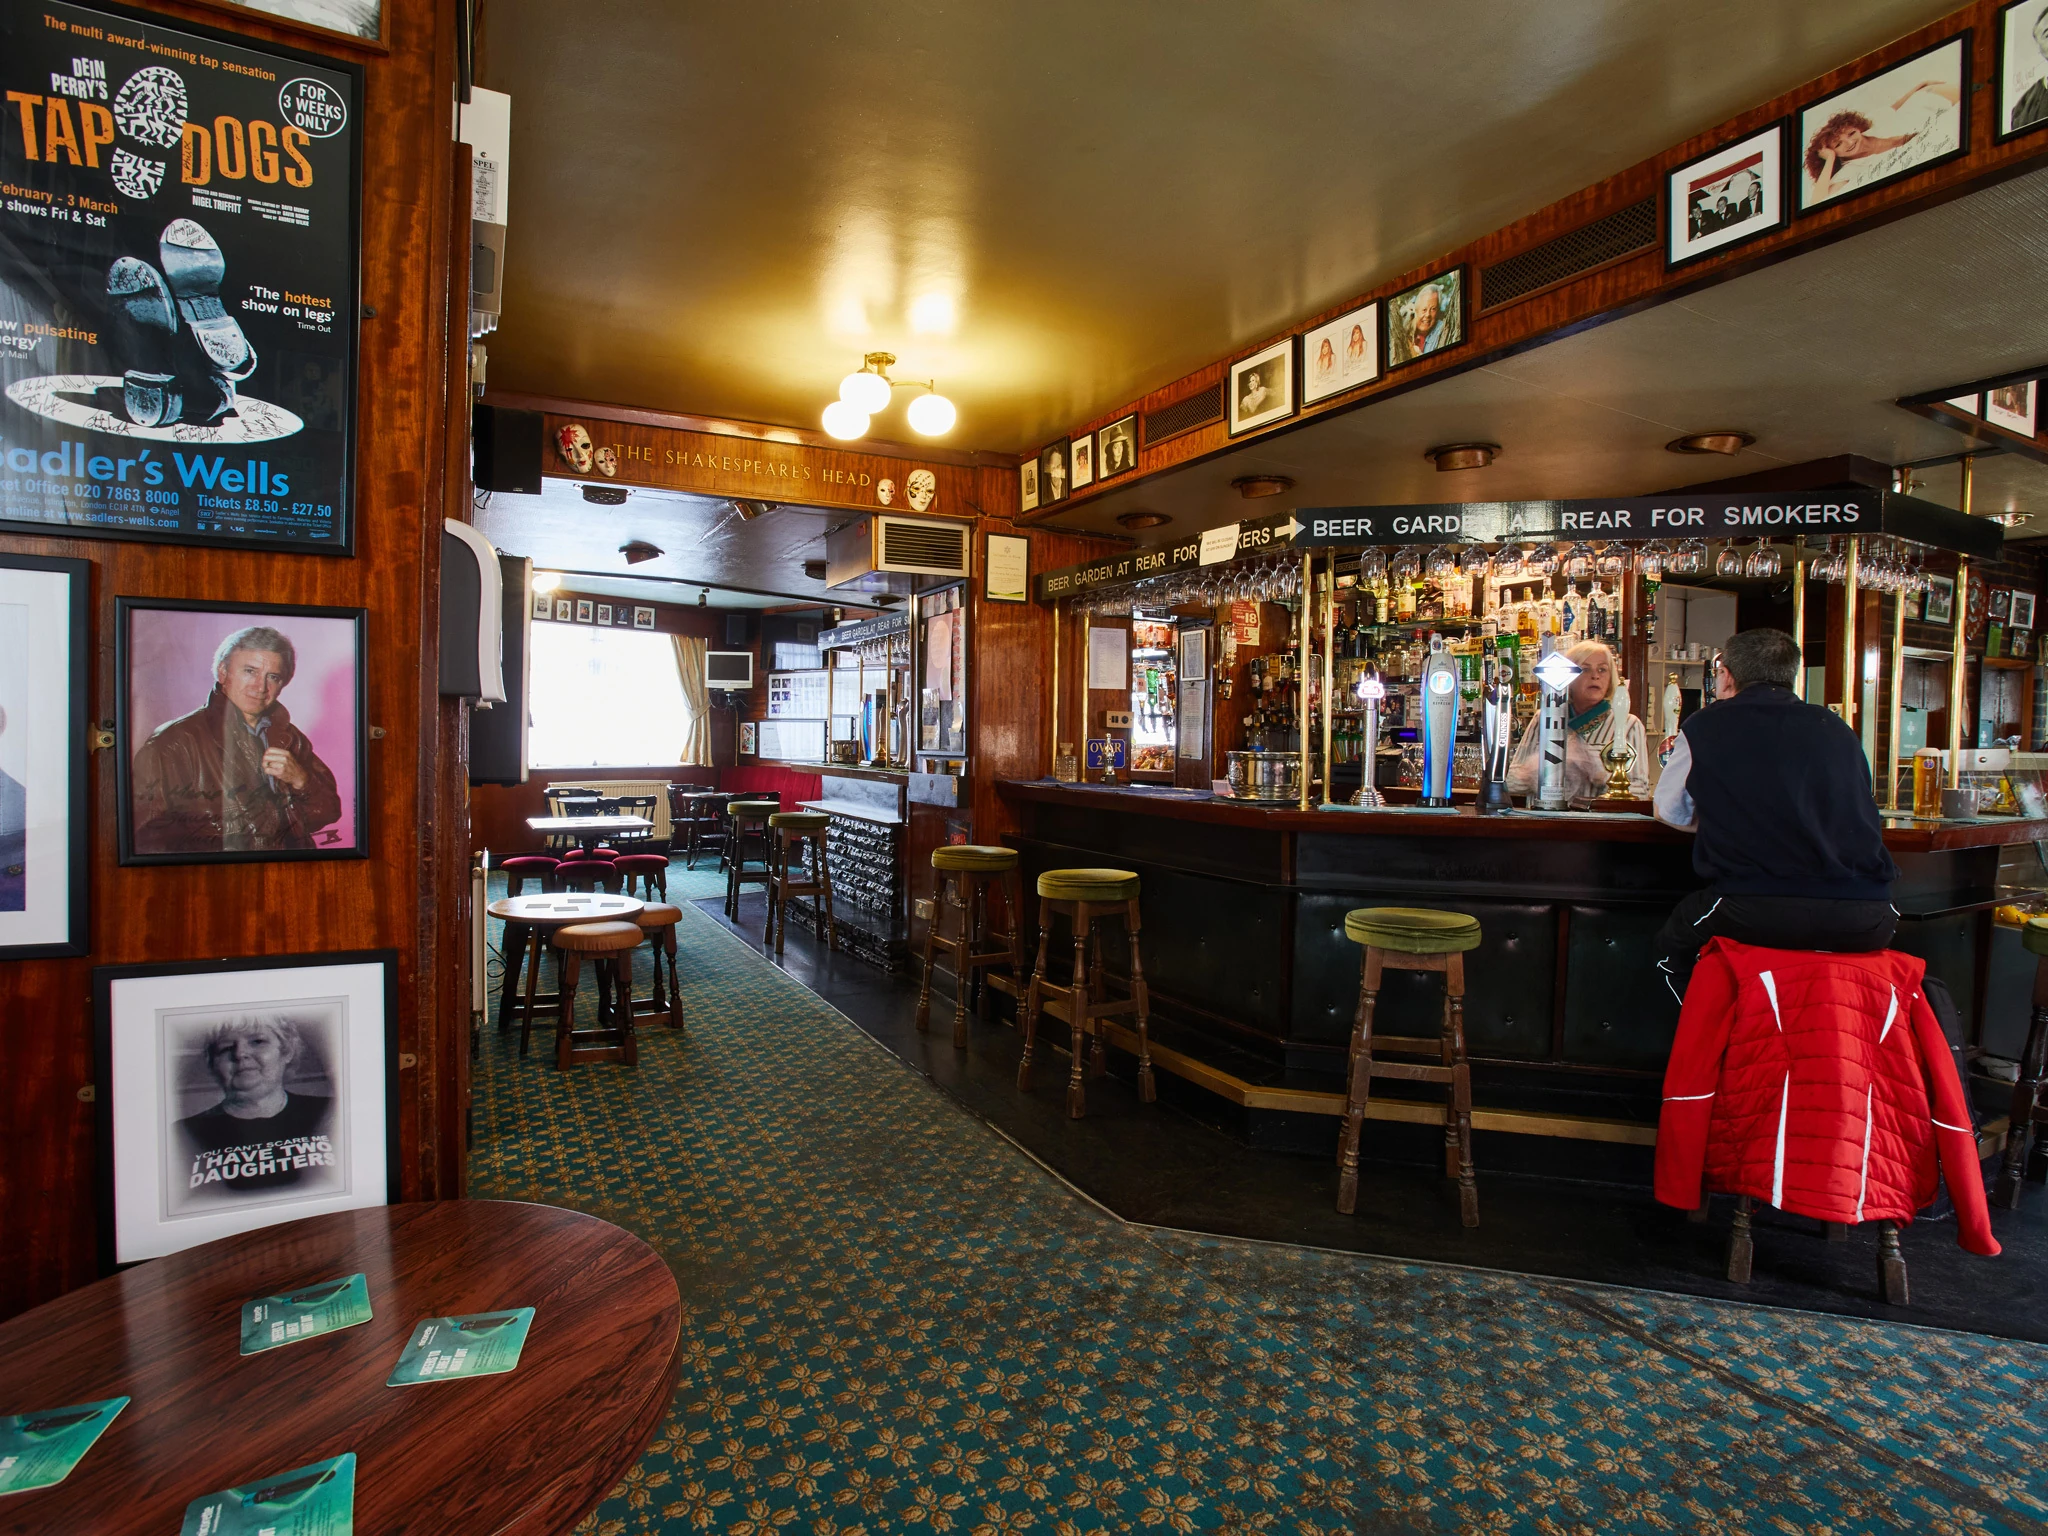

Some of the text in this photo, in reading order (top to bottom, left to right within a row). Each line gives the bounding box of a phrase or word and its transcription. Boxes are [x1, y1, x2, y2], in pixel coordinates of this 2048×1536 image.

[44, 14, 276, 82] The multi award-winning tap sensation
[72, 57, 106, 79] DEIN
[51, 72, 108, 100] PERRY'S
[300, 83, 326, 102] FOR
[283, 94, 342, 120] 3 WEEKS
[295, 112, 330, 132] ONLY
[6, 90, 313, 188] TAP DOGS
[474, 159, 494, 169] SPEL
[7, 200, 48, 217] shows
[52, 206, 68, 220] Fri
[72, 210, 82, 223] &
[86, 213, 106, 228] Sat
[68, 194, 75, 206] 3
[80, 196, 118, 214] March
[192, 195, 242, 214] NIGEL TRIFFITT
[242, 299, 278, 314] show
[282, 306, 300, 317] on
[284, 291, 332, 309] hottest
[24, 323, 98, 344] pulsating
[297, 321, 332, 333] Time Out
[0, 334, 42, 350] ergy’
[8, 350, 28, 360] Mail
[172, 452, 290, 498] Wells
[612, 444, 871, 486] THE SHAKESPEARE'S HEAD
[0, 479, 179, 506] ket Office 020 7863 8000
[6, 505, 40, 517] online
[44, 509, 54, 518] at
[58, 510, 179, 528] www.sadlers-wells.com
[80, 501, 106, 510] London
[109, 502, 128, 512] EC1R
[130, 504, 146, 512] 4TN
[160, 507, 180, 516] Angel
[196, 494, 240, 510] Tickets
[244, 498, 278, 513] £8.50
[292, 502, 332, 518] £27.50
[1312, 518, 1372, 536] BEER
[1392, 514, 1496, 534] GARDE
[1561, 508, 1632, 530] REAR
[1652, 507, 1705, 528] FOR
[1724, 502, 1860, 526] SMOKERS
[1048, 526, 1271, 592] BEER GARDEN AT REAR FOR KERS
[842, 630, 852, 640] BEER
[852, 625, 869, 638] GARDEN
[870, 624, 876, 632] AT
[877, 620, 890, 631] REAR
[892, 616, 902, 627] FOR
[1245, 612, 1257, 624] 18
[1499, 712, 1508, 748] GUINNESS
[1090, 742, 1122, 753] OVR
[192, 1142, 332, 1174] I HAVE TWO
[196, 1149, 220, 1160] YOU
[224, 1144, 262, 1153] CAN'T
[266, 1137, 310, 1148] SCARE
[190, 1152, 336, 1188] DAUGHTERS
